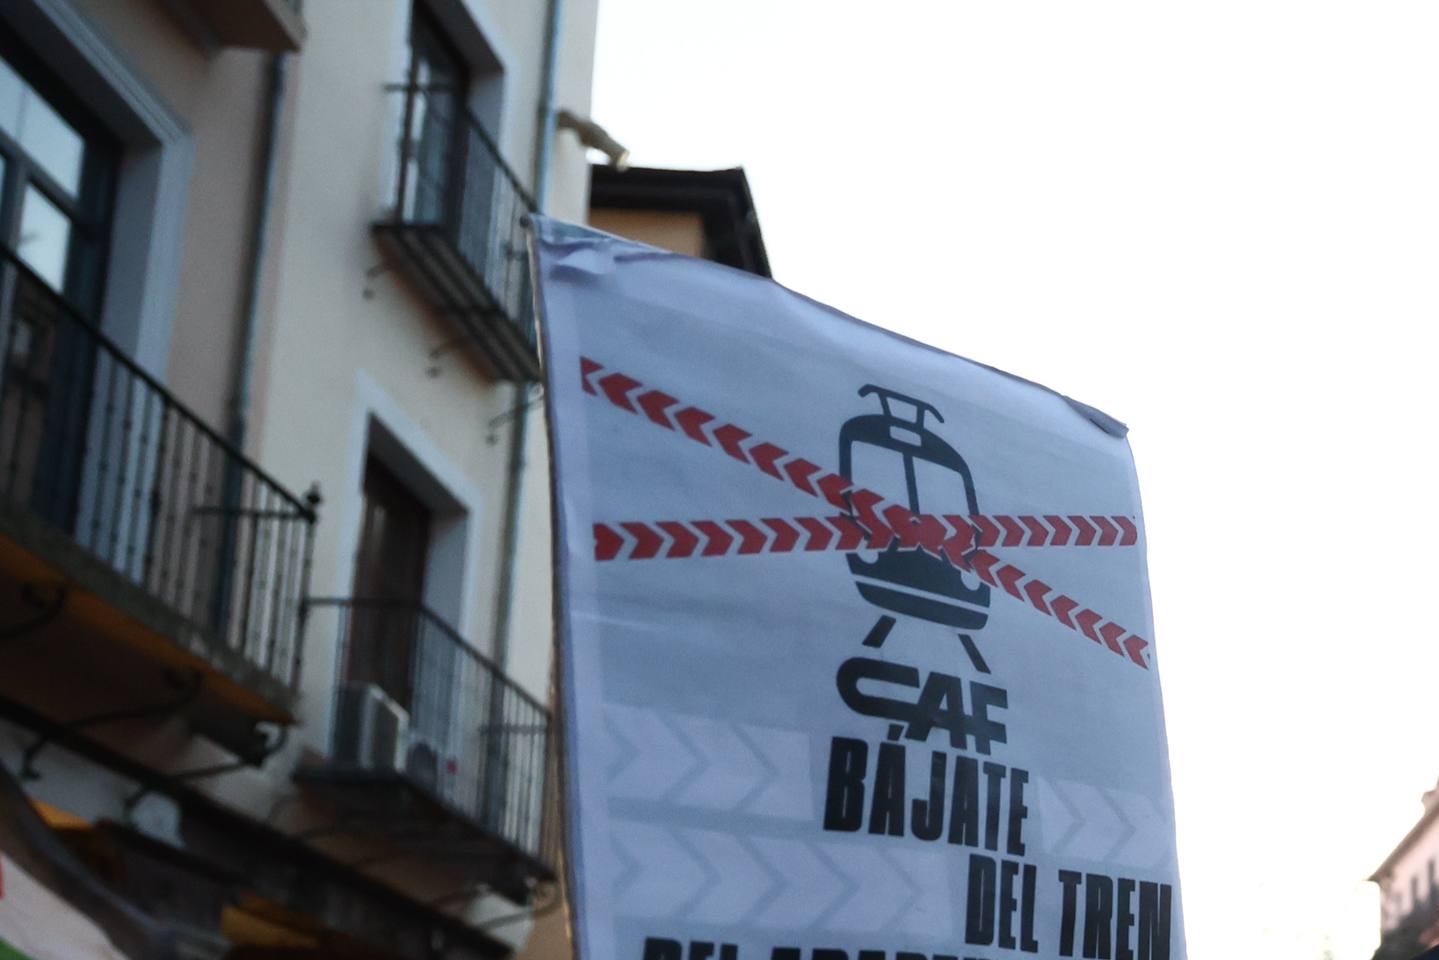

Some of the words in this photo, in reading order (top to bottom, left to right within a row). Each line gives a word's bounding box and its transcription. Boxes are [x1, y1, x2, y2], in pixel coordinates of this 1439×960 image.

[836, 656, 1009, 756] CAF
[823, 723, 1030, 857] BÁJATE
[964, 852, 1039, 954] DEL
